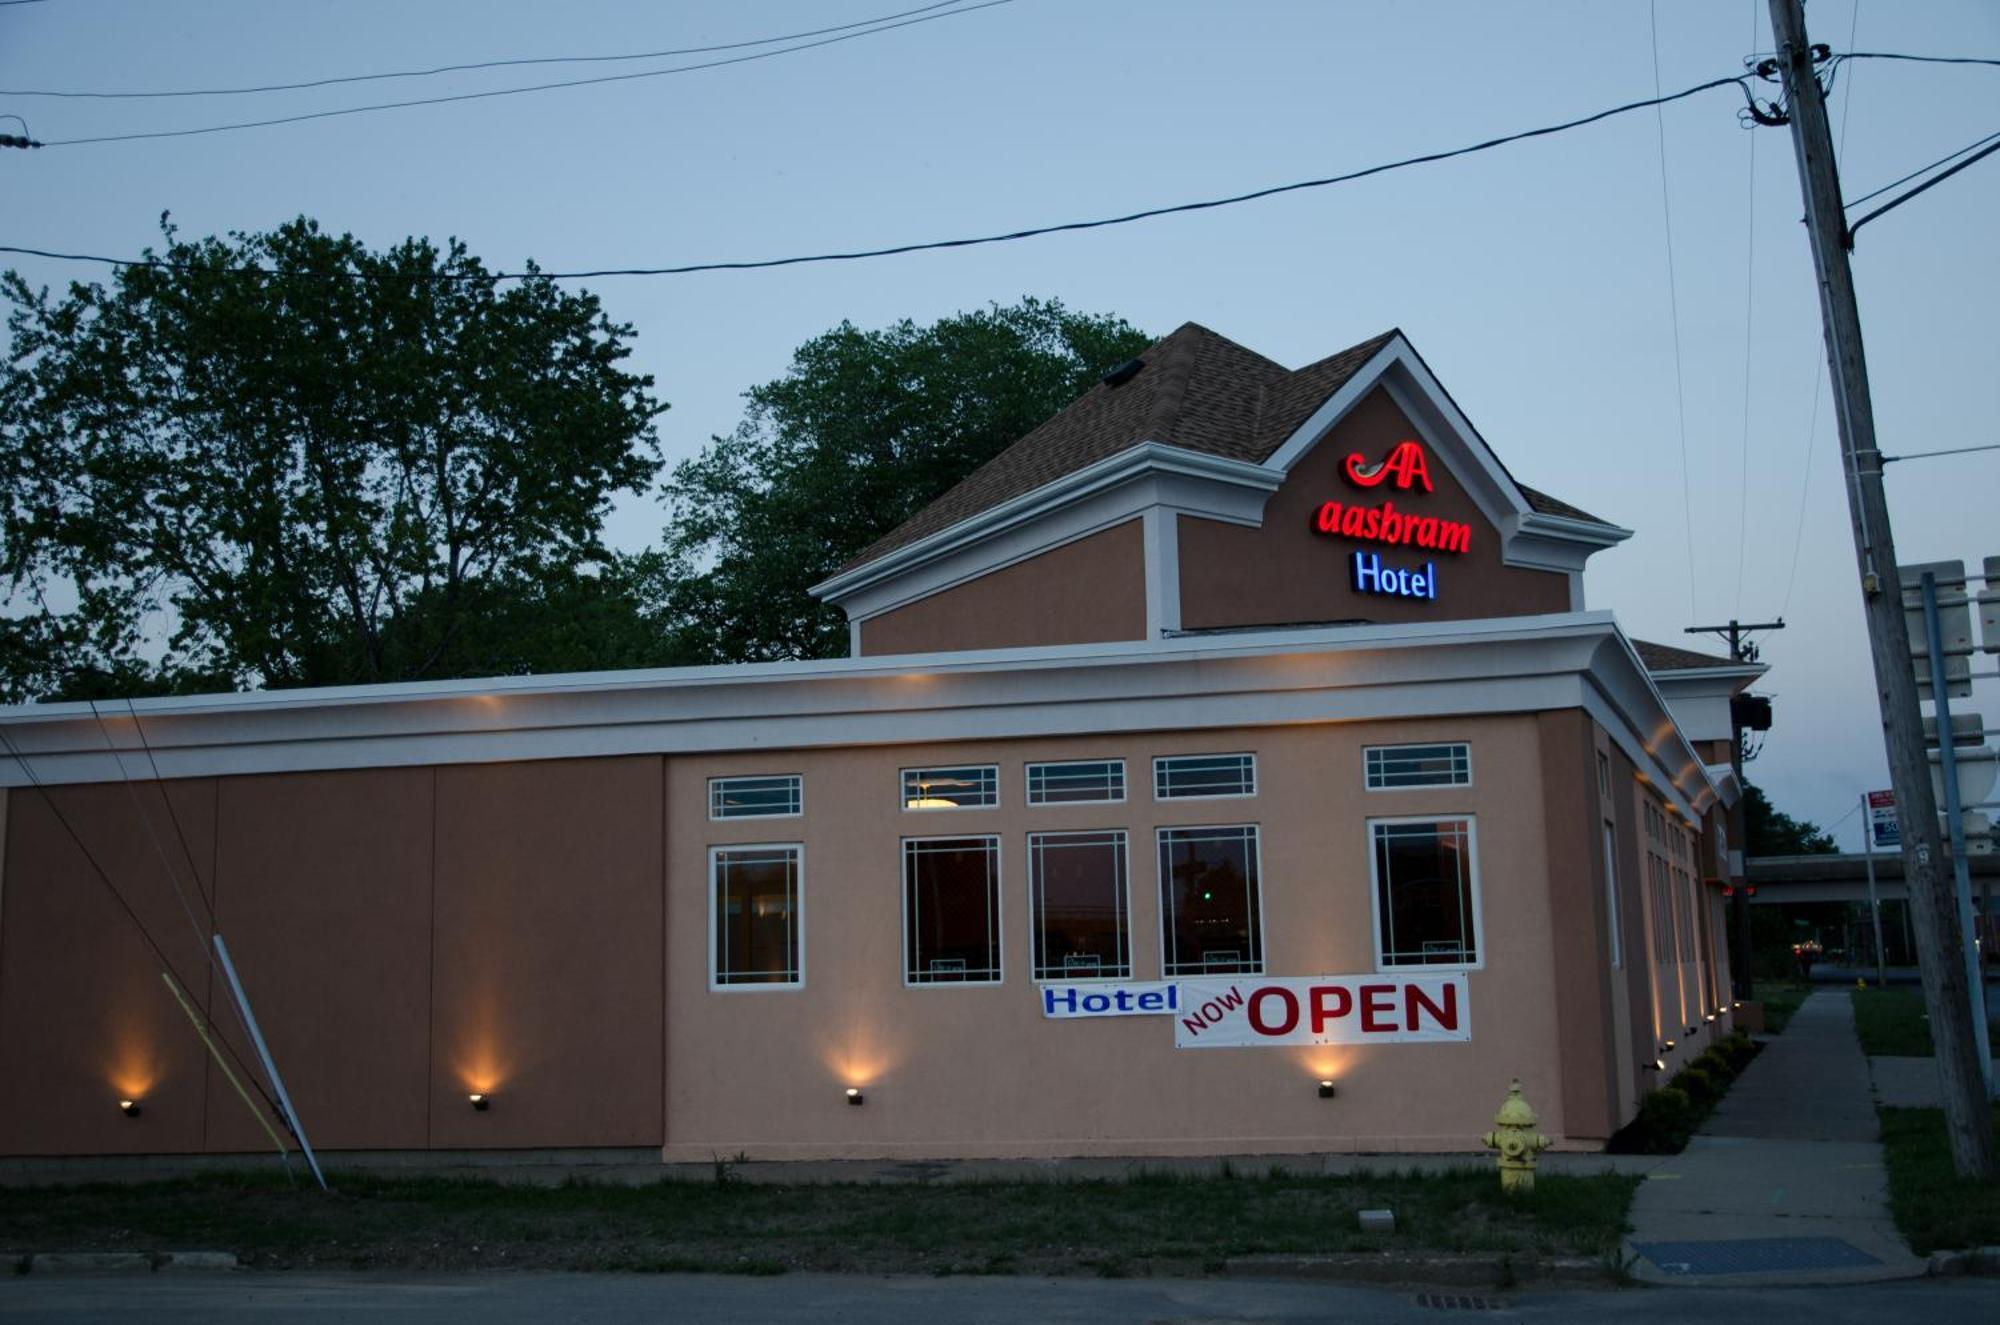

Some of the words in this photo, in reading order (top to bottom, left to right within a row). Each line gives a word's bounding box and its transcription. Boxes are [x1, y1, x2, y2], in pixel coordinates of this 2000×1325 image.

[1355, 551, 1436, 599] Hotel
[1045, 984, 1177, 1014] Hotel
[1182, 985, 1244, 1036] NOW
[1247, 983, 1459, 1036] OPEN
